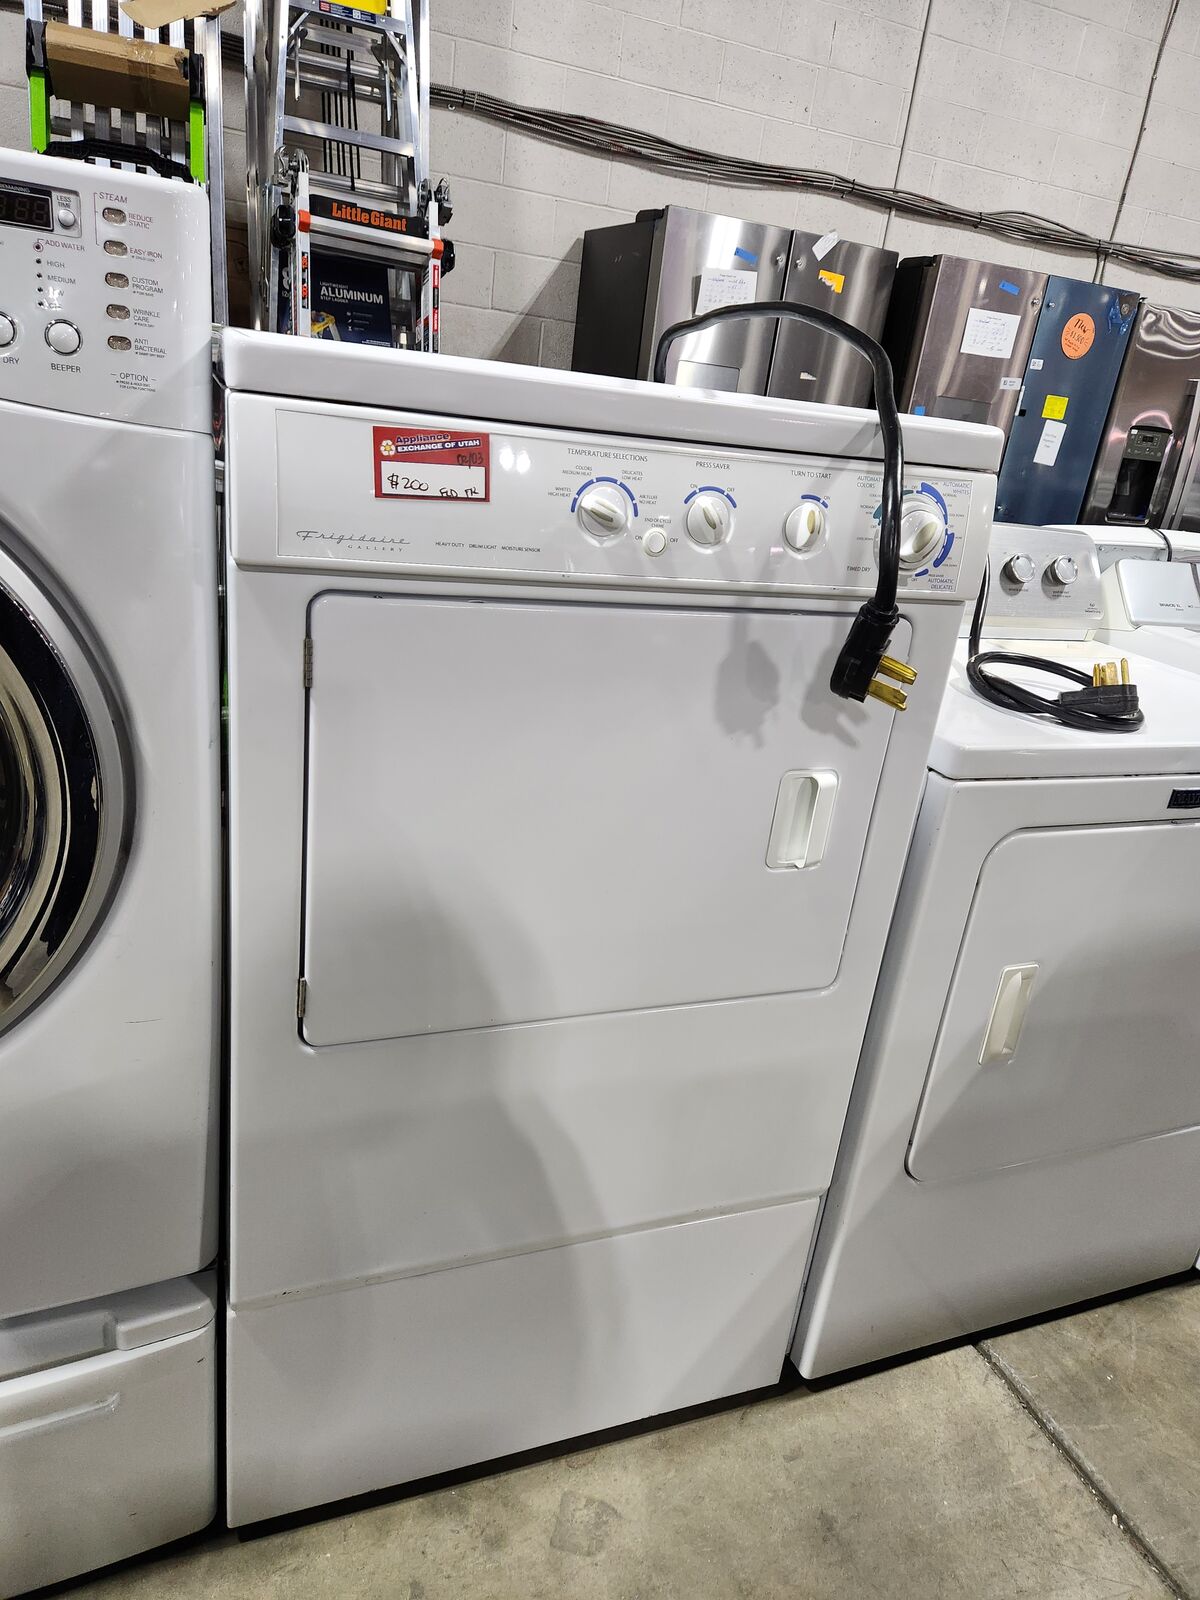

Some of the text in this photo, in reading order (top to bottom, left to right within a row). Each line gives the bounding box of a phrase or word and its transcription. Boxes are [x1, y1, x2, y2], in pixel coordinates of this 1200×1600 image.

[57, 195, 71, 203] LESS
[99, 192, 128, 204] STEAM
[128, 212, 153, 223] REDUCE
[332, 201, 407, 231] Little Giant
[128, 220, 150, 229] STATIC
[45, 239, 85, 251] ADD WATER
[130, 247, 163, 259] EASY IRON
[46, 259, 65, 268] HIGH
[47, 274, 76, 284] MEDIUM
[131, 276, 158, 286] CUSTOM
[132, 283, 163, 294] PROGRAM
[320, 286, 384, 305] ALUMINUM
[133, 308, 160, 318] WRINKLE
[133, 315, 150, 323] CARE
[134, 338, 149, 346] ANTI
[134, 344, 167, 355] BACTERIAL
[2, 356, 20, 365] DRY
[50, 362, 81, 374] BEEPER
[119, 372, 149, 382] OPTION
[396, 432, 450, 444] Appliance
[397, 439, 480, 453] EXCHANGE OF UTAH
[567, 447, 648, 462] TEMPERATURE SELECTIONS
[695, 460, 730, 470] PRESS SAVER
[791, 469, 806, 477] TURN
[815, 472, 832, 480] START
[387, 473, 429, 491] $200
[942, 481, 970, 489] AUTOMATIC
[296, 530, 410, 544] Frigidaire
[347, 544, 403, 552] GALLERY
